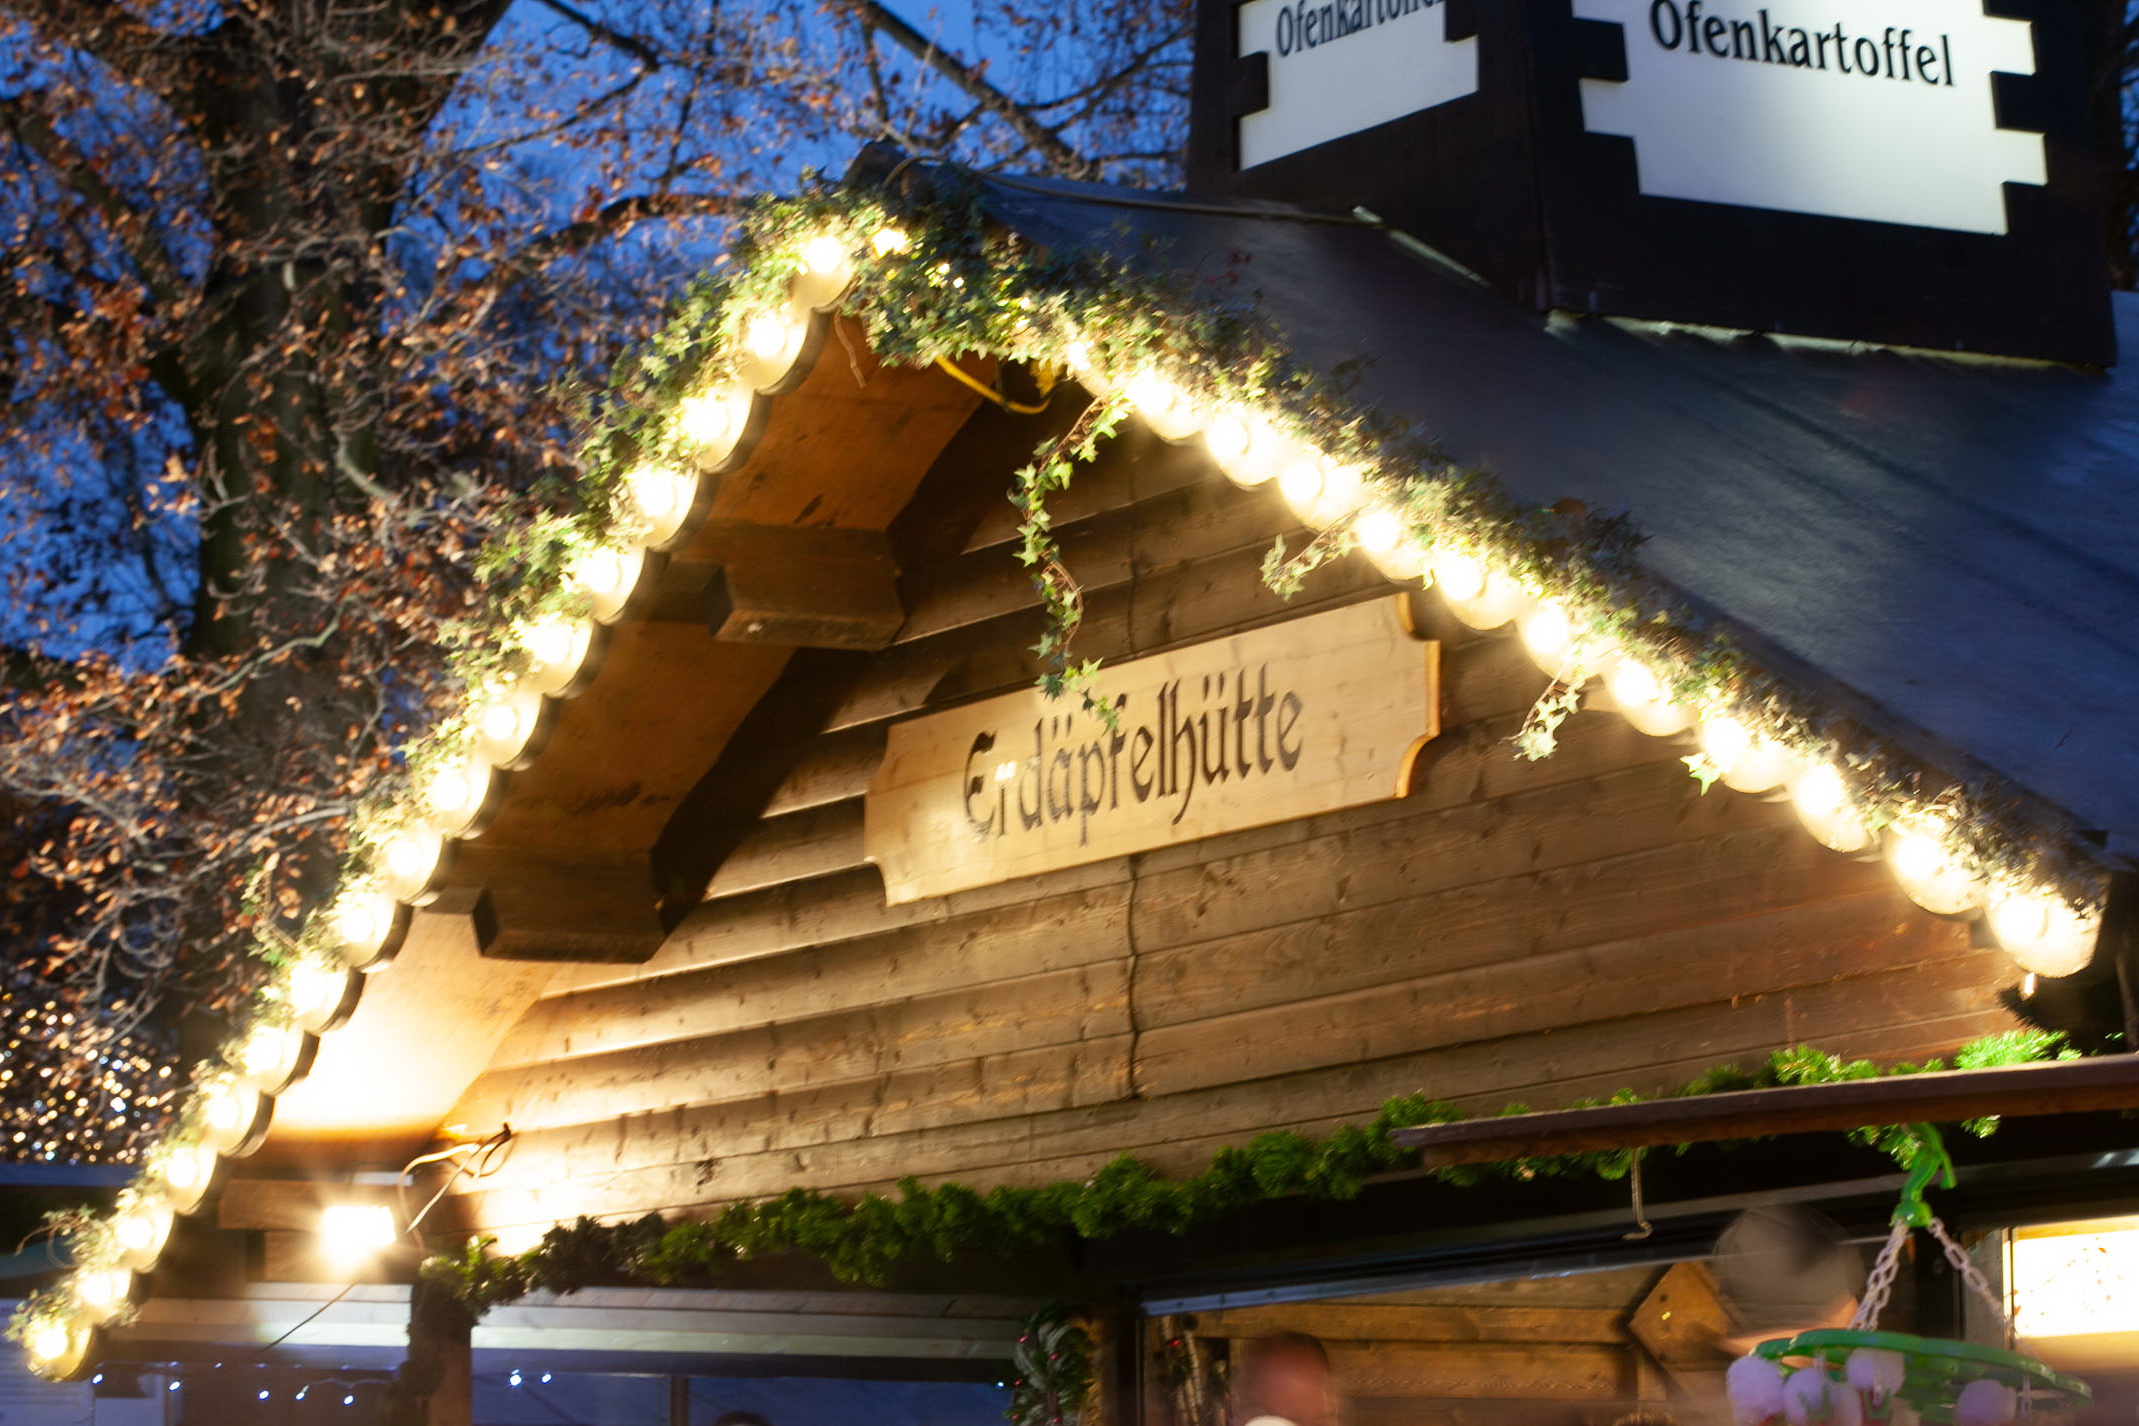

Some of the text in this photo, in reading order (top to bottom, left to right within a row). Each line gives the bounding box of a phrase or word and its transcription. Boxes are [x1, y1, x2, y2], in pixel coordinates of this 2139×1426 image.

[1276, 0, 1442, 57] Ofenkarto
[1649, 0, 1956, 87] Ofenkartoffel
[963, 662, 1303, 848] Erdäpfelhütte
